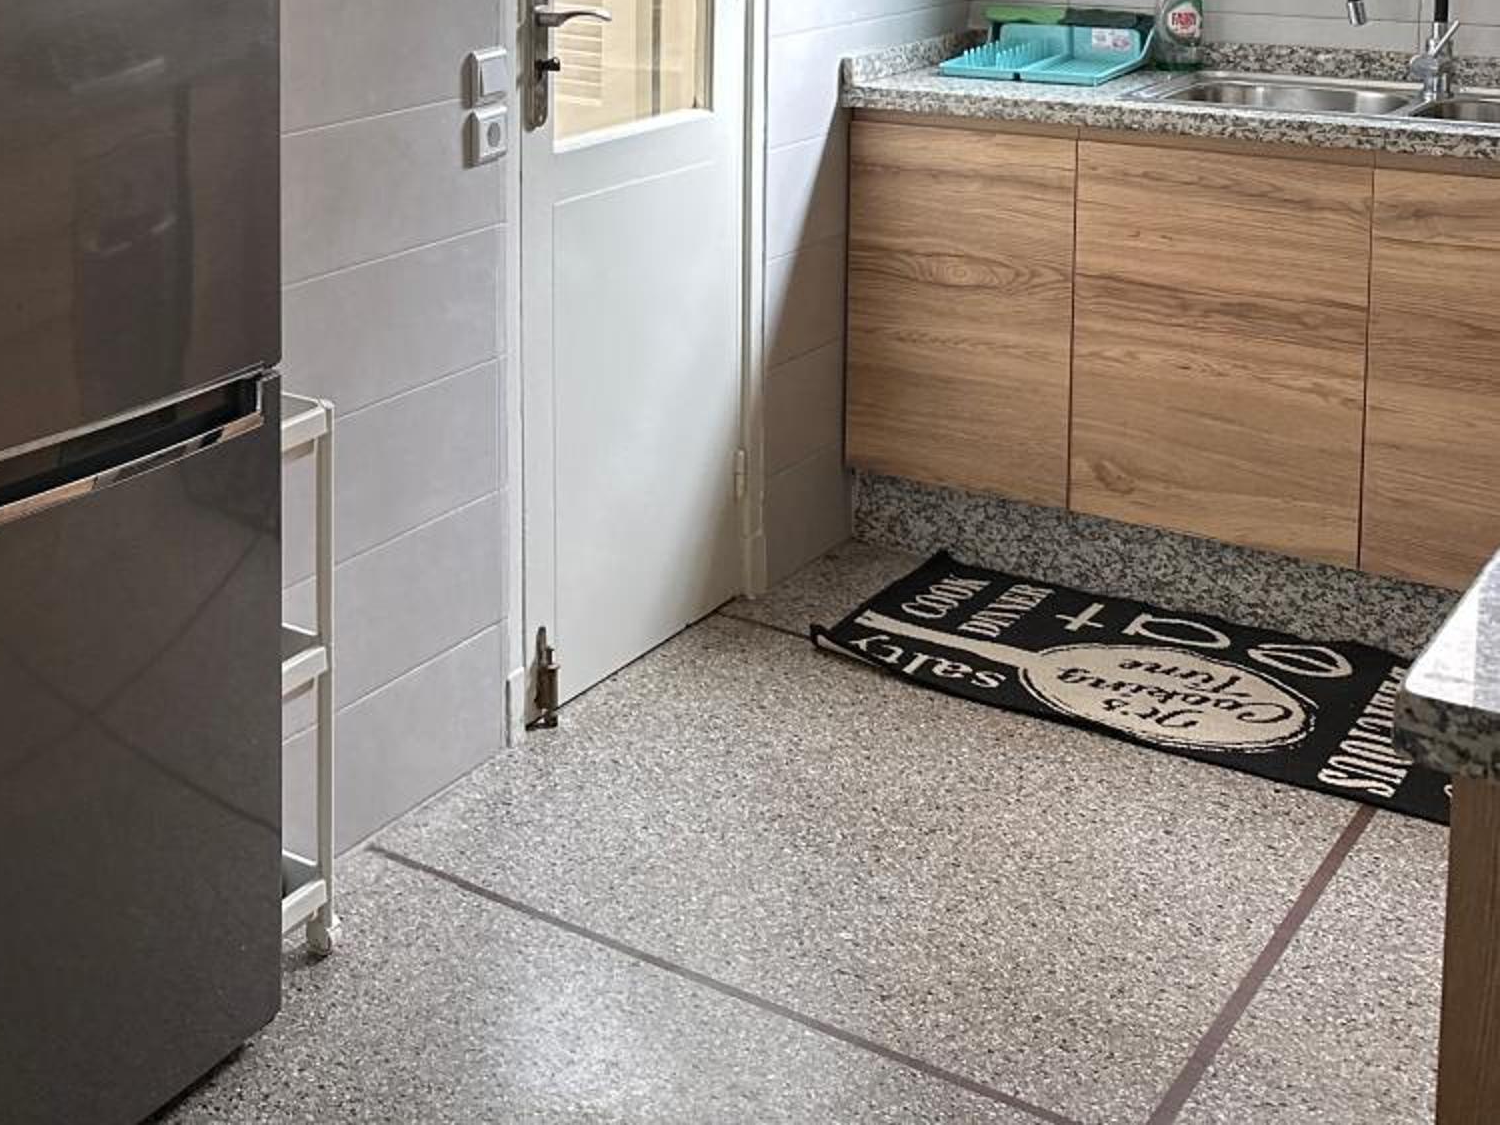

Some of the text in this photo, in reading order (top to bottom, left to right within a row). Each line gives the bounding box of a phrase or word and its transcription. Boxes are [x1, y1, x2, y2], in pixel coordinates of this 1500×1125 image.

[901, 574, 992, 619] COOK
[850, 634, 1007, 688] salty
[1118, 657, 1252, 698] Time
[1056, 668, 1293, 724] Cooking
[1102, 697, 1204, 728] It's
